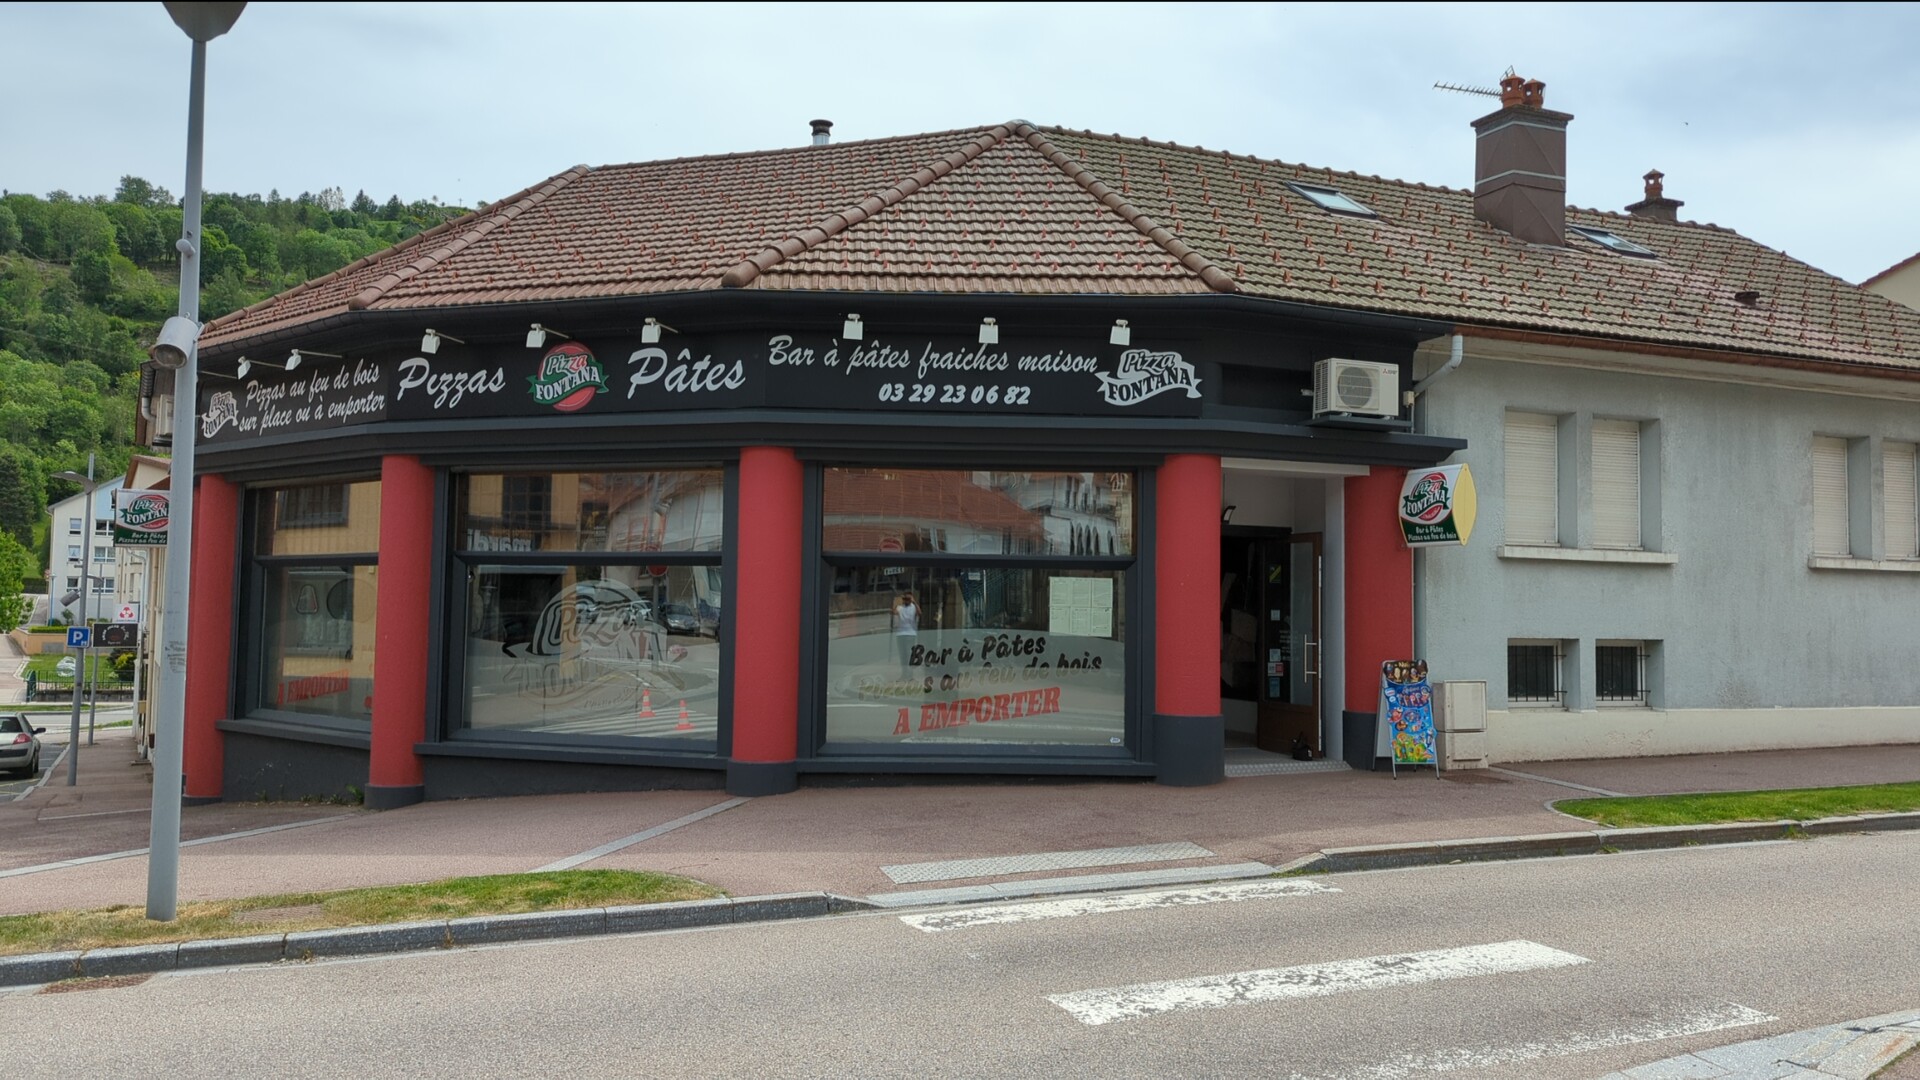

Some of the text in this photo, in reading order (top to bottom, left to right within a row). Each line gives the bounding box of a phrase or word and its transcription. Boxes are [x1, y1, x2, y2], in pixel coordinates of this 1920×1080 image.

[546, 354, 588, 375] Pizza
[627, 347, 746, 399] Pâtes
[768, 335, 1098, 380] Bar à pâtes fraiches maison
[1122, 351, 1176, 375] Pizza
[245, 358, 380, 412] Pizzas au feu de bois
[397, 357, 506, 409] Pizzas
[535, 366, 601, 401] FONTANA
[878, 383, 905, 402] 03
[908, 384, 936, 403] 29
[940, 384, 966, 403] 23
[1003, 385, 1031, 405] 82
[1107, 367, 1193, 402] FONTANA
[239, 391, 386, 436] sur place ou à emporter
[135, 500, 166, 511] Pizza
[1407, 490, 1446, 514] FONTANA
[1415, 481, 1442, 496] Pizza
[127, 508, 168, 524] FONTAN
[73, 630, 84, 643] P
[909, 633, 1047, 667] Bar à Pâtes
[940, 672, 973, 692] au
[979, 661, 1016, 687] feu
[1022, 657, 1050, 682] de
[1056, 651, 1103, 678] bois
[893, 686, 1061, 735] A EMPORTER
